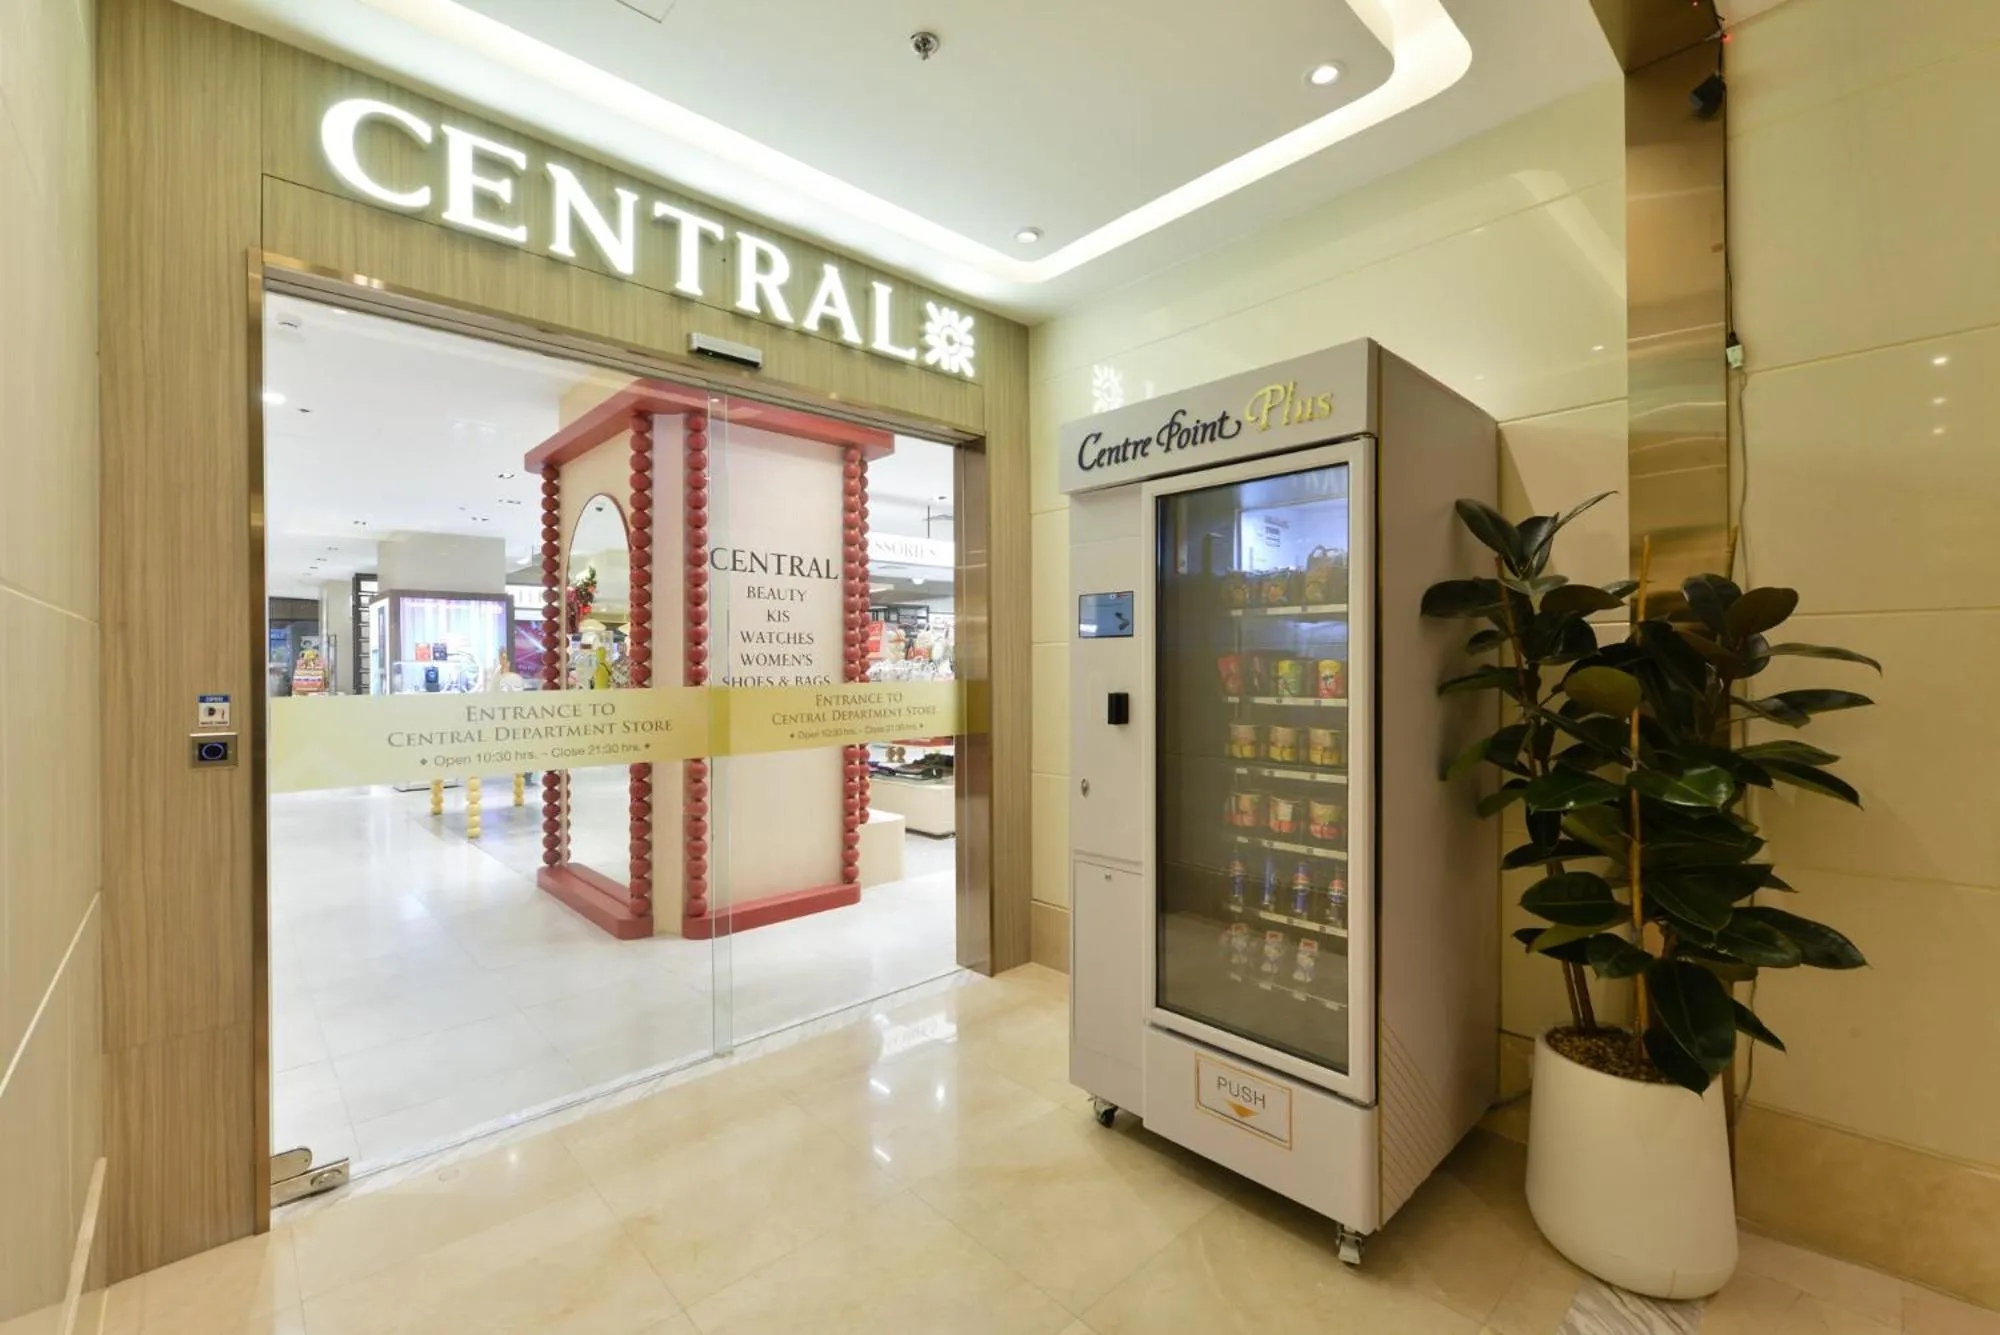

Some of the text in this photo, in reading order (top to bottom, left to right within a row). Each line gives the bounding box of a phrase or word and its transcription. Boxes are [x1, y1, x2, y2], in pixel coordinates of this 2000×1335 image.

[320, 97, 917, 362] CENTRAL
[1077, 380, 1334, 472] Centre Point Plus
[710, 547, 839, 580] CENTRAL
[746, 585, 808, 602] BEAUTY
[767, 609, 790, 622] KIS
[740, 630, 815, 645] WATCHES
[740, 652, 813, 666] WOMEN'S
[815, 692, 903, 707] ENTRANCE TO
[466, 702, 616, 722] ENTRANCE TO
[772, 711, 827, 726] CENTRAL
[832, 708, 901, 721] DEPARTMENT
[387, 720, 673, 747] CENTRAL DEPARTMENT STORE
[433, 754, 472, 767] Open
[476, 750, 512, 763] 10:30
[551, 746, 586, 758] Close
[587, 743, 620, 755] 21:30
[1217, 1076, 1266, 1109] PUSH
